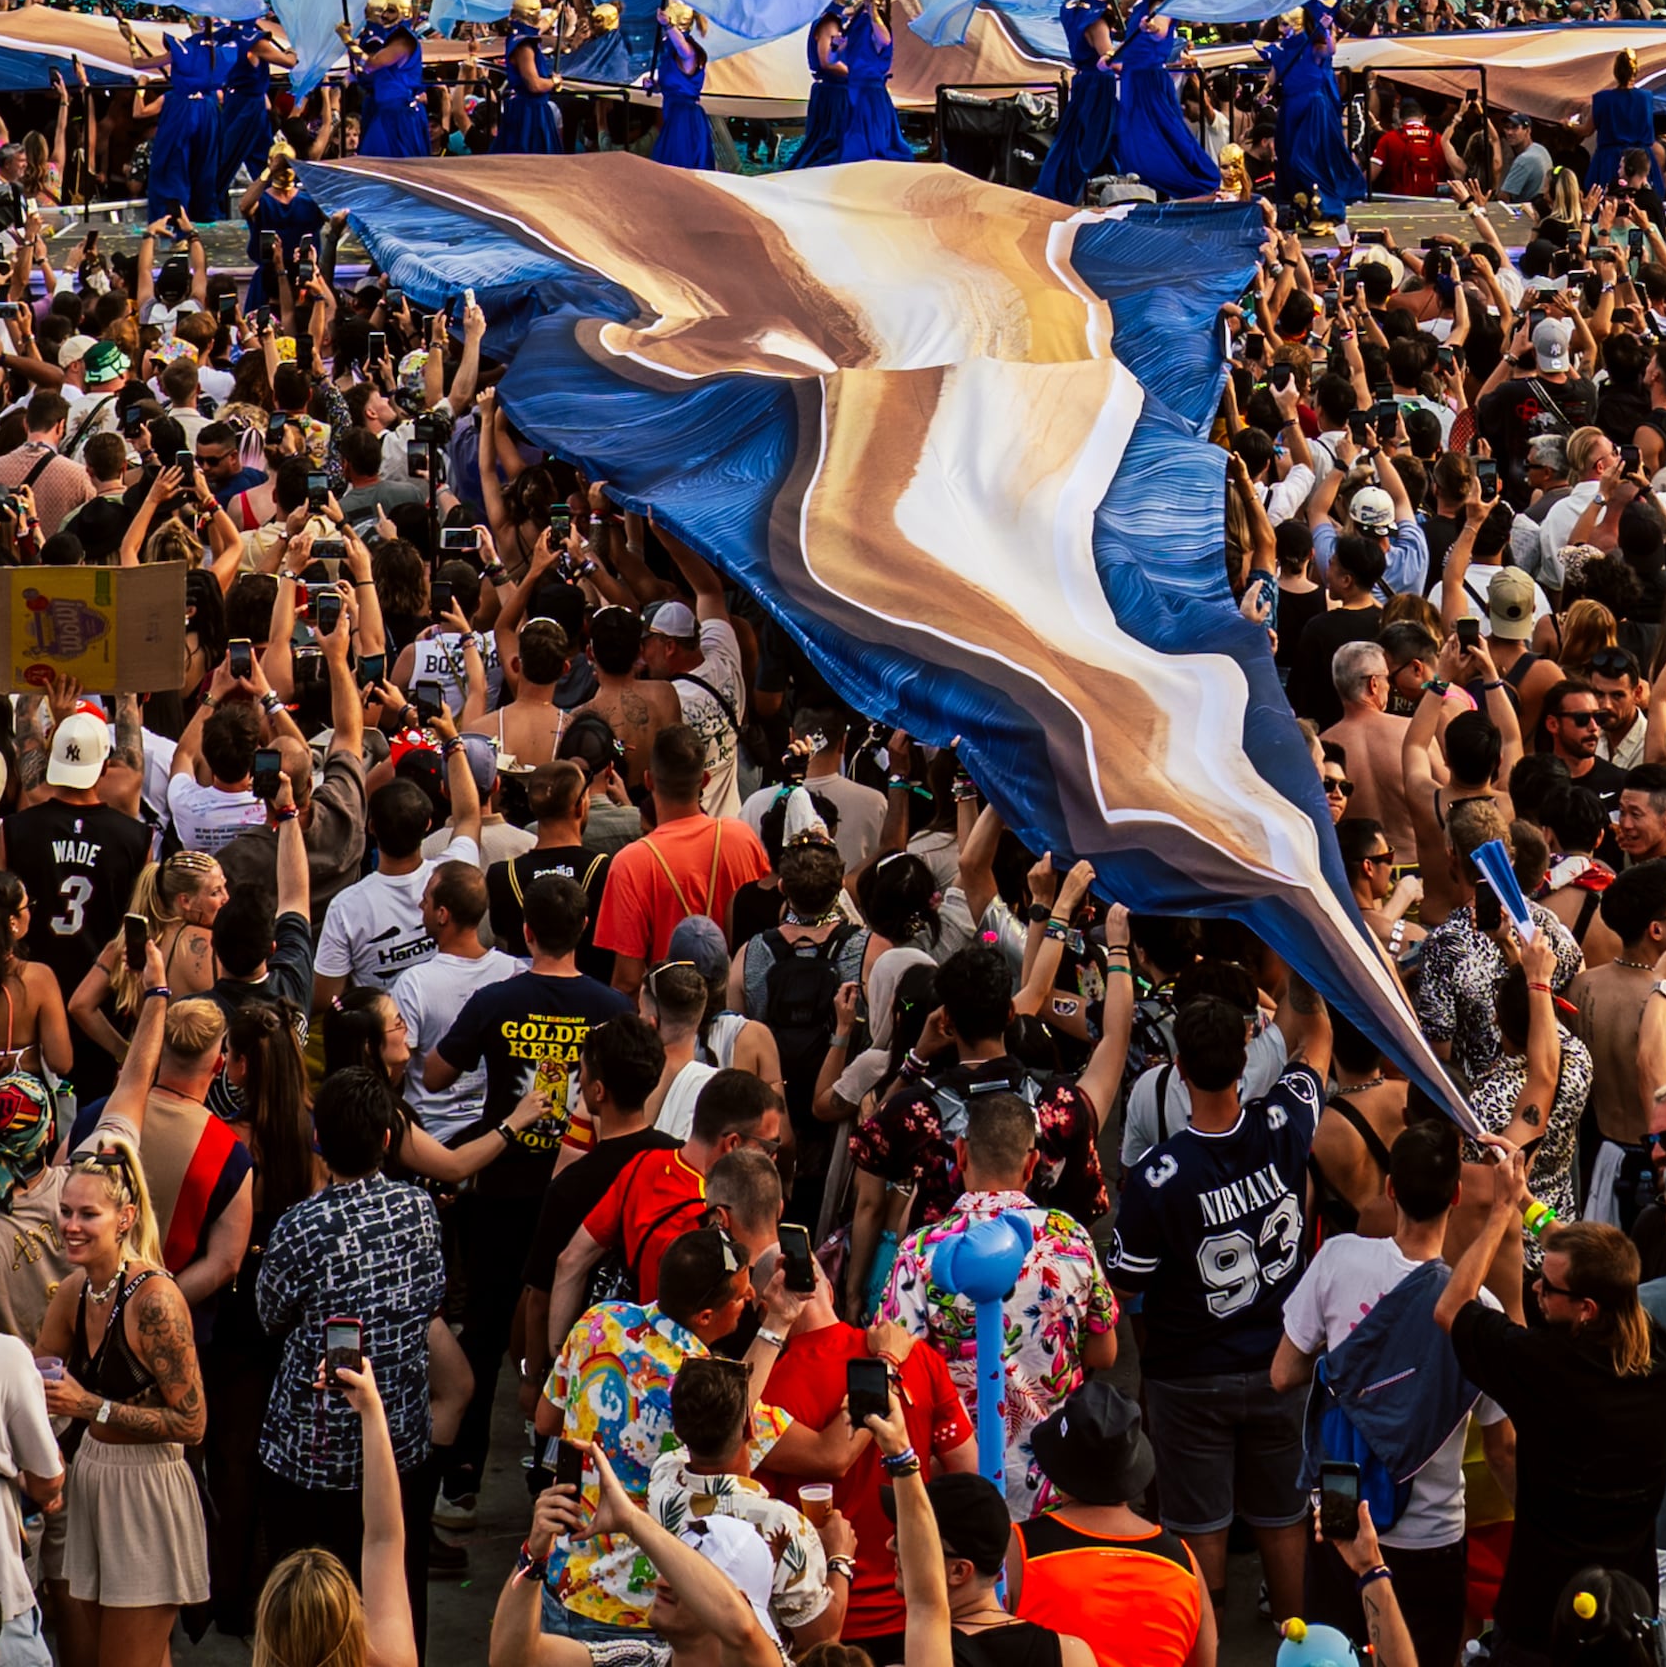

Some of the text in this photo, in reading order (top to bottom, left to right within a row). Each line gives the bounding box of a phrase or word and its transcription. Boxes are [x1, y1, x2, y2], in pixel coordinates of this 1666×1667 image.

[65, 744, 81, 762] NY
[52, 840, 102, 867] WADE
[50, 875, 94, 936] 3
[377, 935, 439, 965] Hardw
[508, 1040, 580, 1062] KEBA
[1197, 1162, 1289, 1228] NIRVANA
[1196, 1193, 1304, 1319] 93
